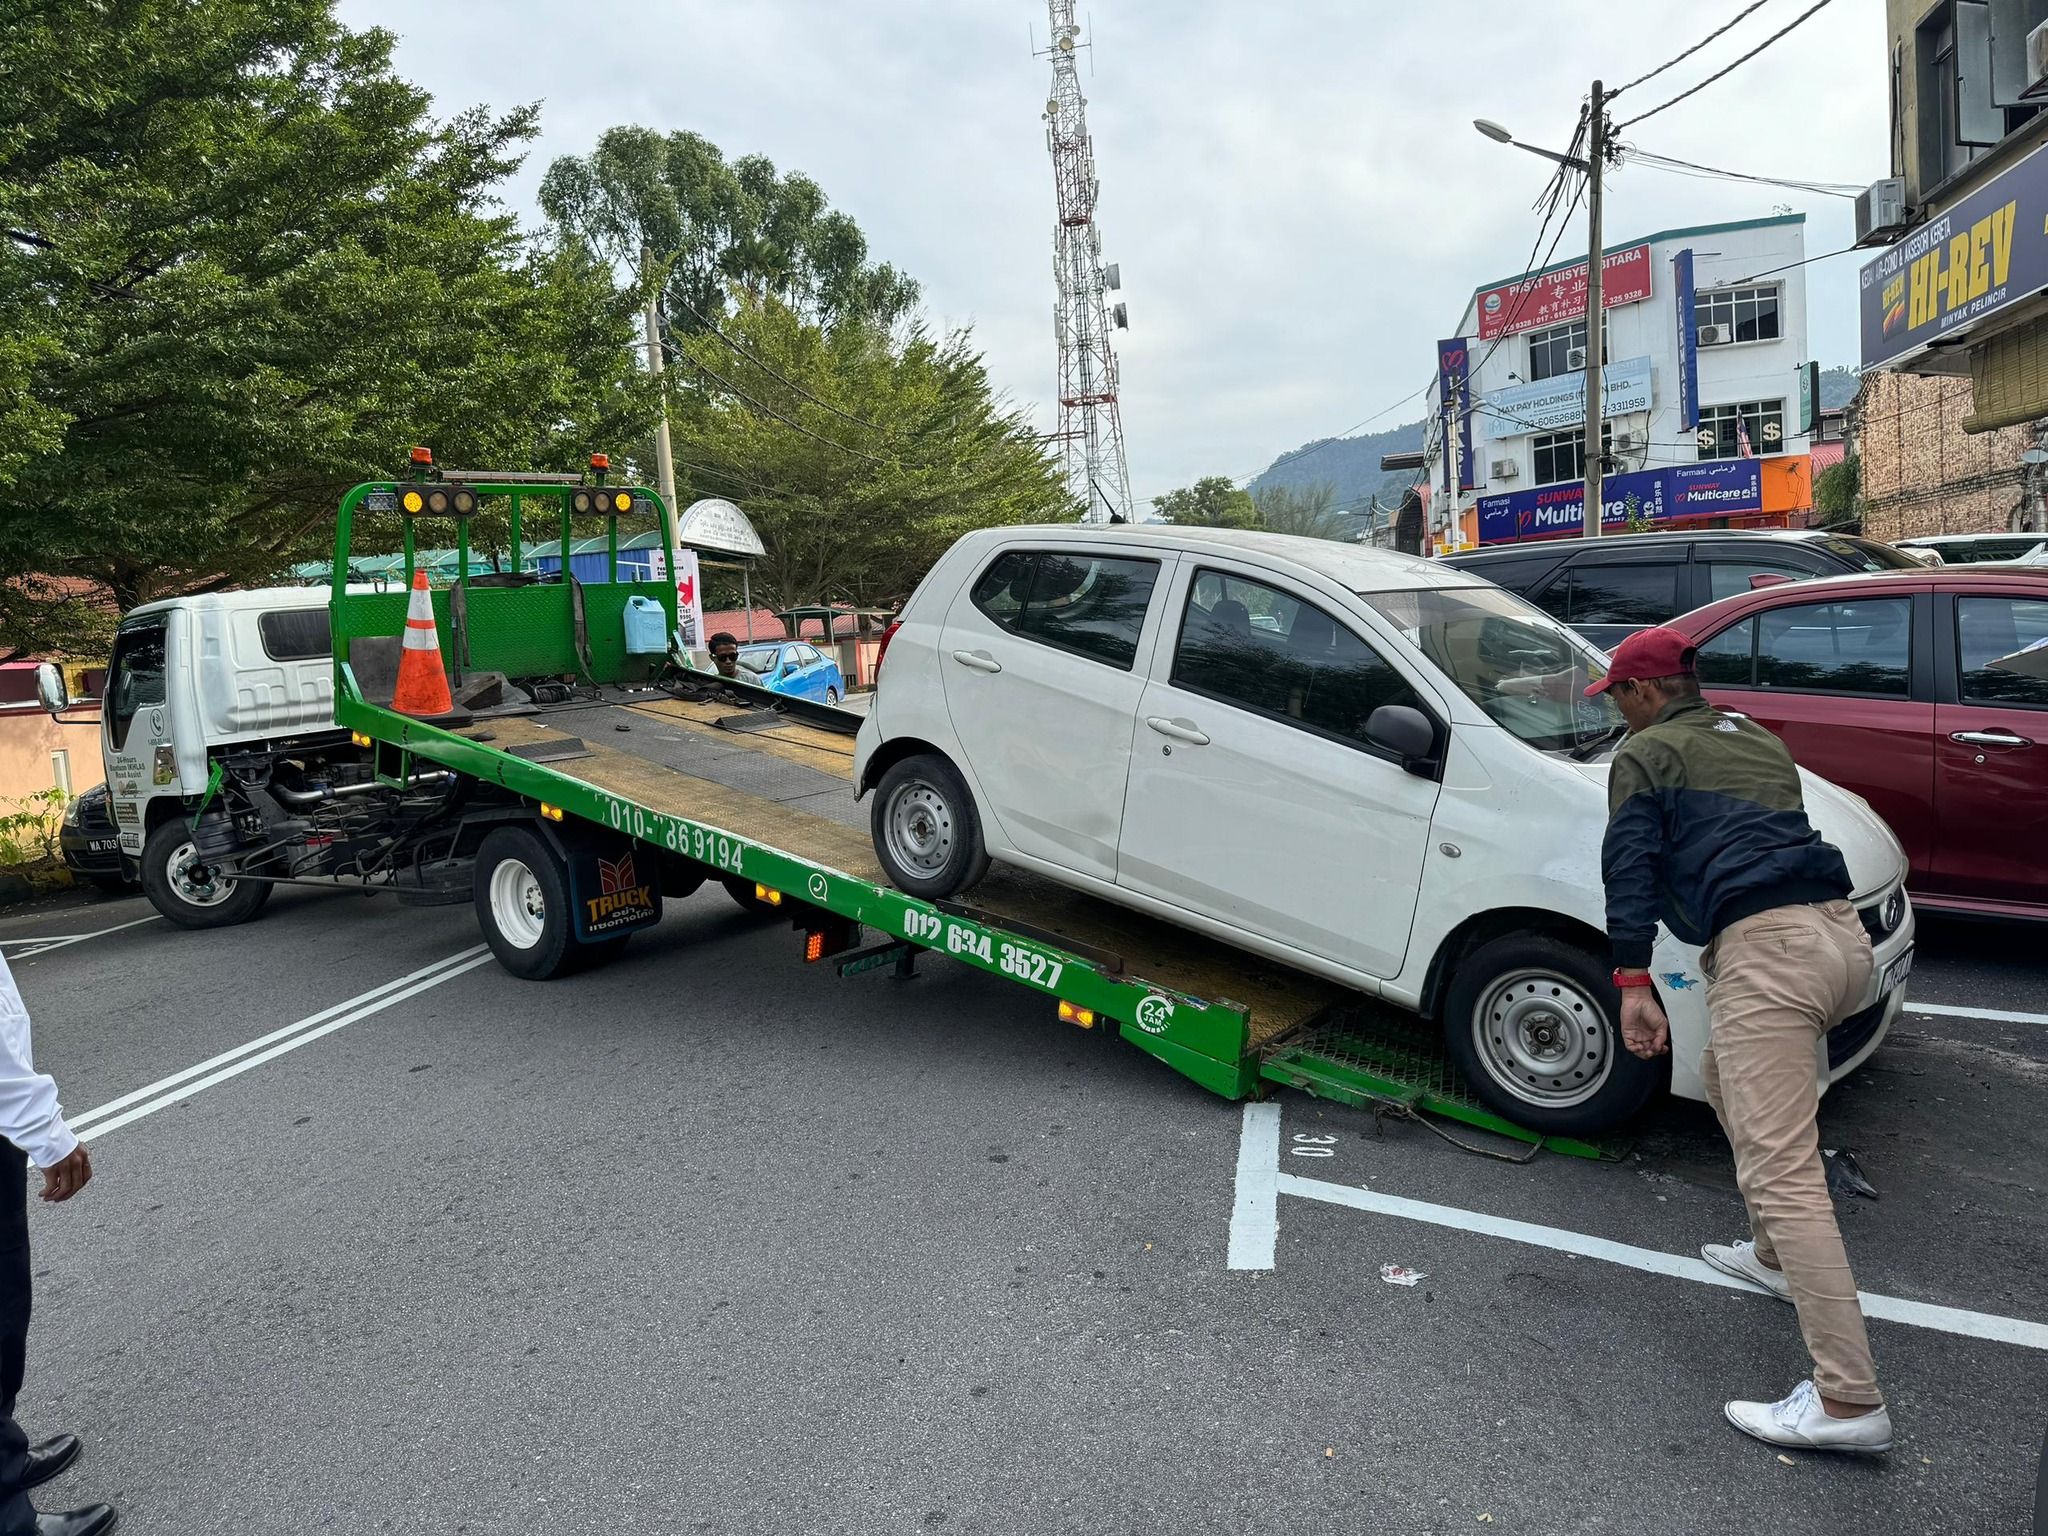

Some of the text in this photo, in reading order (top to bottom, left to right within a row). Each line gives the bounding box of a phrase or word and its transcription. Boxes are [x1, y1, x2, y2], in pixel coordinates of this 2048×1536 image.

[1908, 200, 2017, 331] HI-REV
[1624, 289, 1643, 301] 9328
[1940, 288, 2007, 329] MINYAK PELINCIR
[1486, 328, 1498, 337] 012
[1536, 315, 1549, 324] 017
[1567, 306, 1586, 316] 2234
[1516, 401, 1533, 412] PAY
[1533, 393, 1575, 410] HOLDINGS
[1676, 467, 1707, 478] Farmasi
[1687, 488, 1741, 502] Multicare
[1688, 482, 1721, 491] SUNWAY
[1482, 496, 1511, 509] Farmasi
[587, 885, 654, 923] TRUCK
[904, 907, 1063, 990] 012 634 3527
[1143, 1002, 1166, 1020] 24
[1143, 1015, 1163, 1027] JAM
[1291, 1134, 1339, 1157] 30
